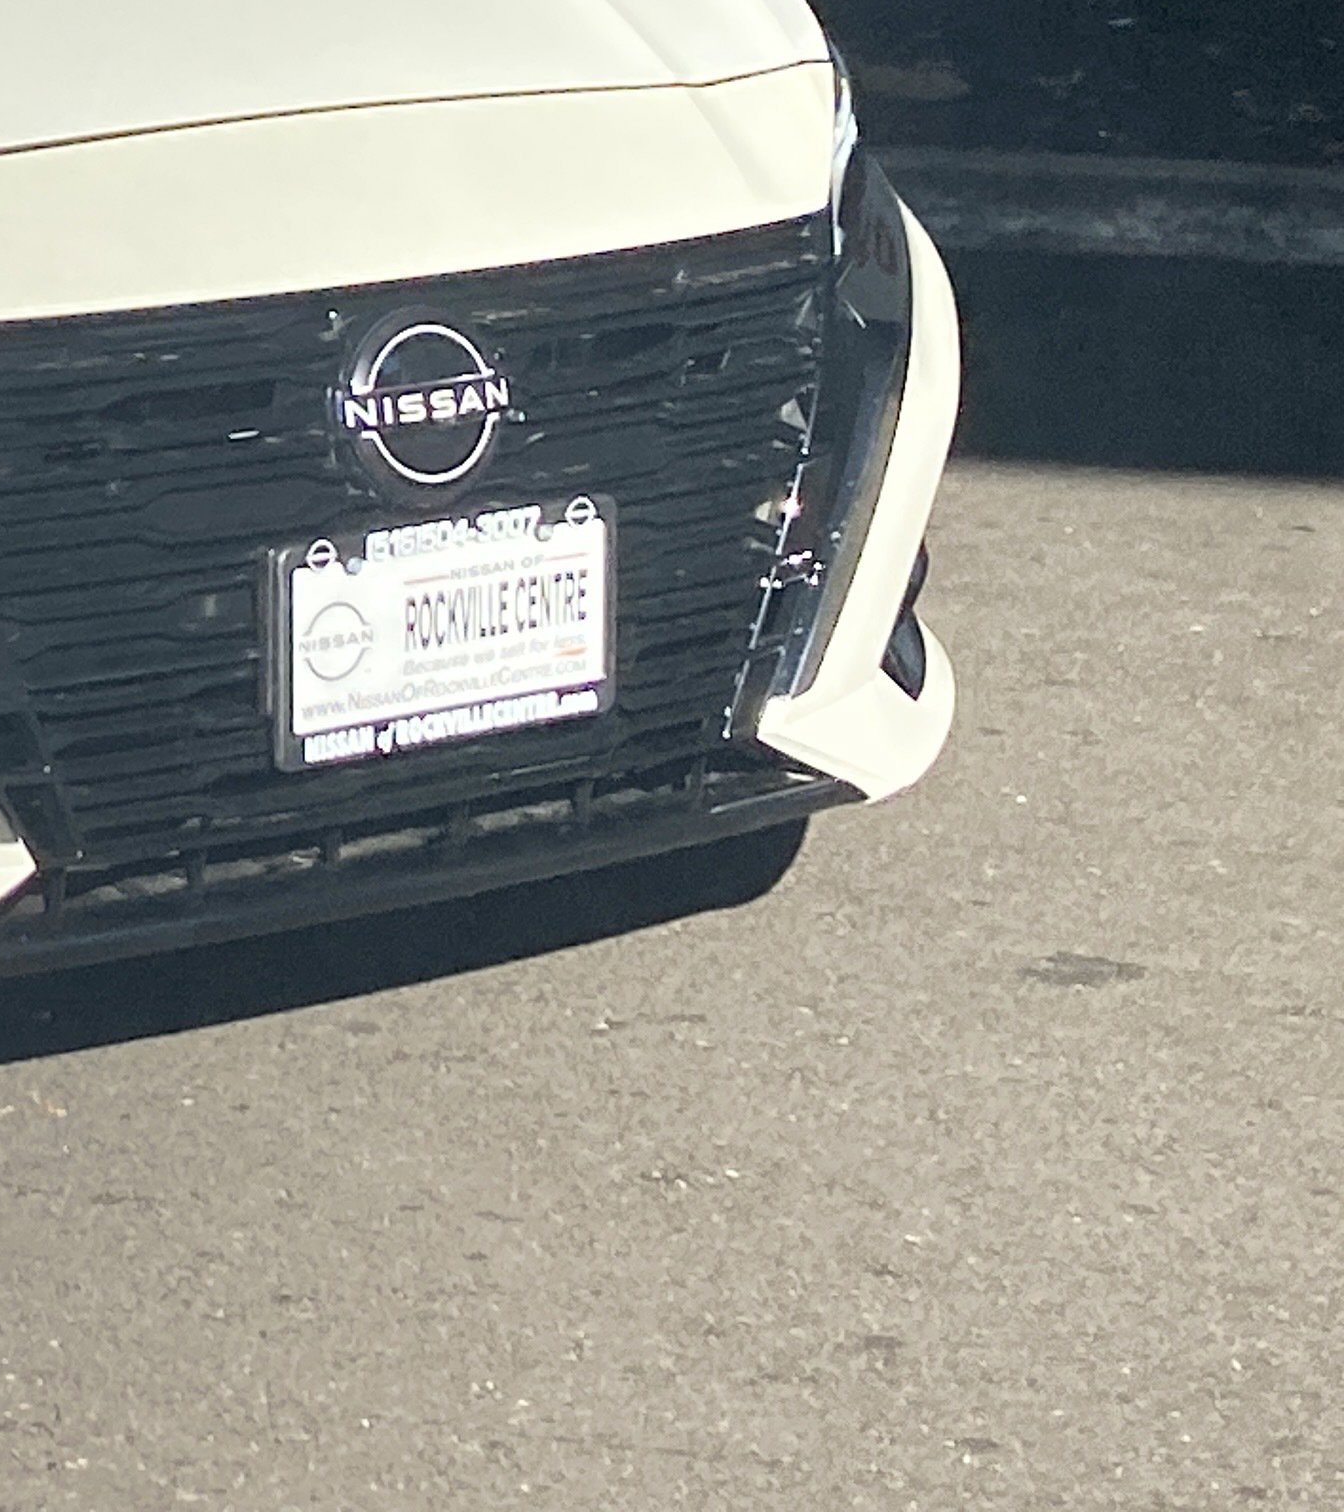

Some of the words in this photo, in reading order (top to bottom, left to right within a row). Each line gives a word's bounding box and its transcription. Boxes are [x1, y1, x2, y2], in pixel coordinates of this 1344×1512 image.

[344, 377, 509, 428] NISSAN
[450, 558, 515, 581] NISSAN
[520, 553, 545, 570] OF
[403, 580, 510, 653] ROCKVILLE
[514, 568, 589, 631] CENTRE
[298, 628, 375, 653] NISSAN
